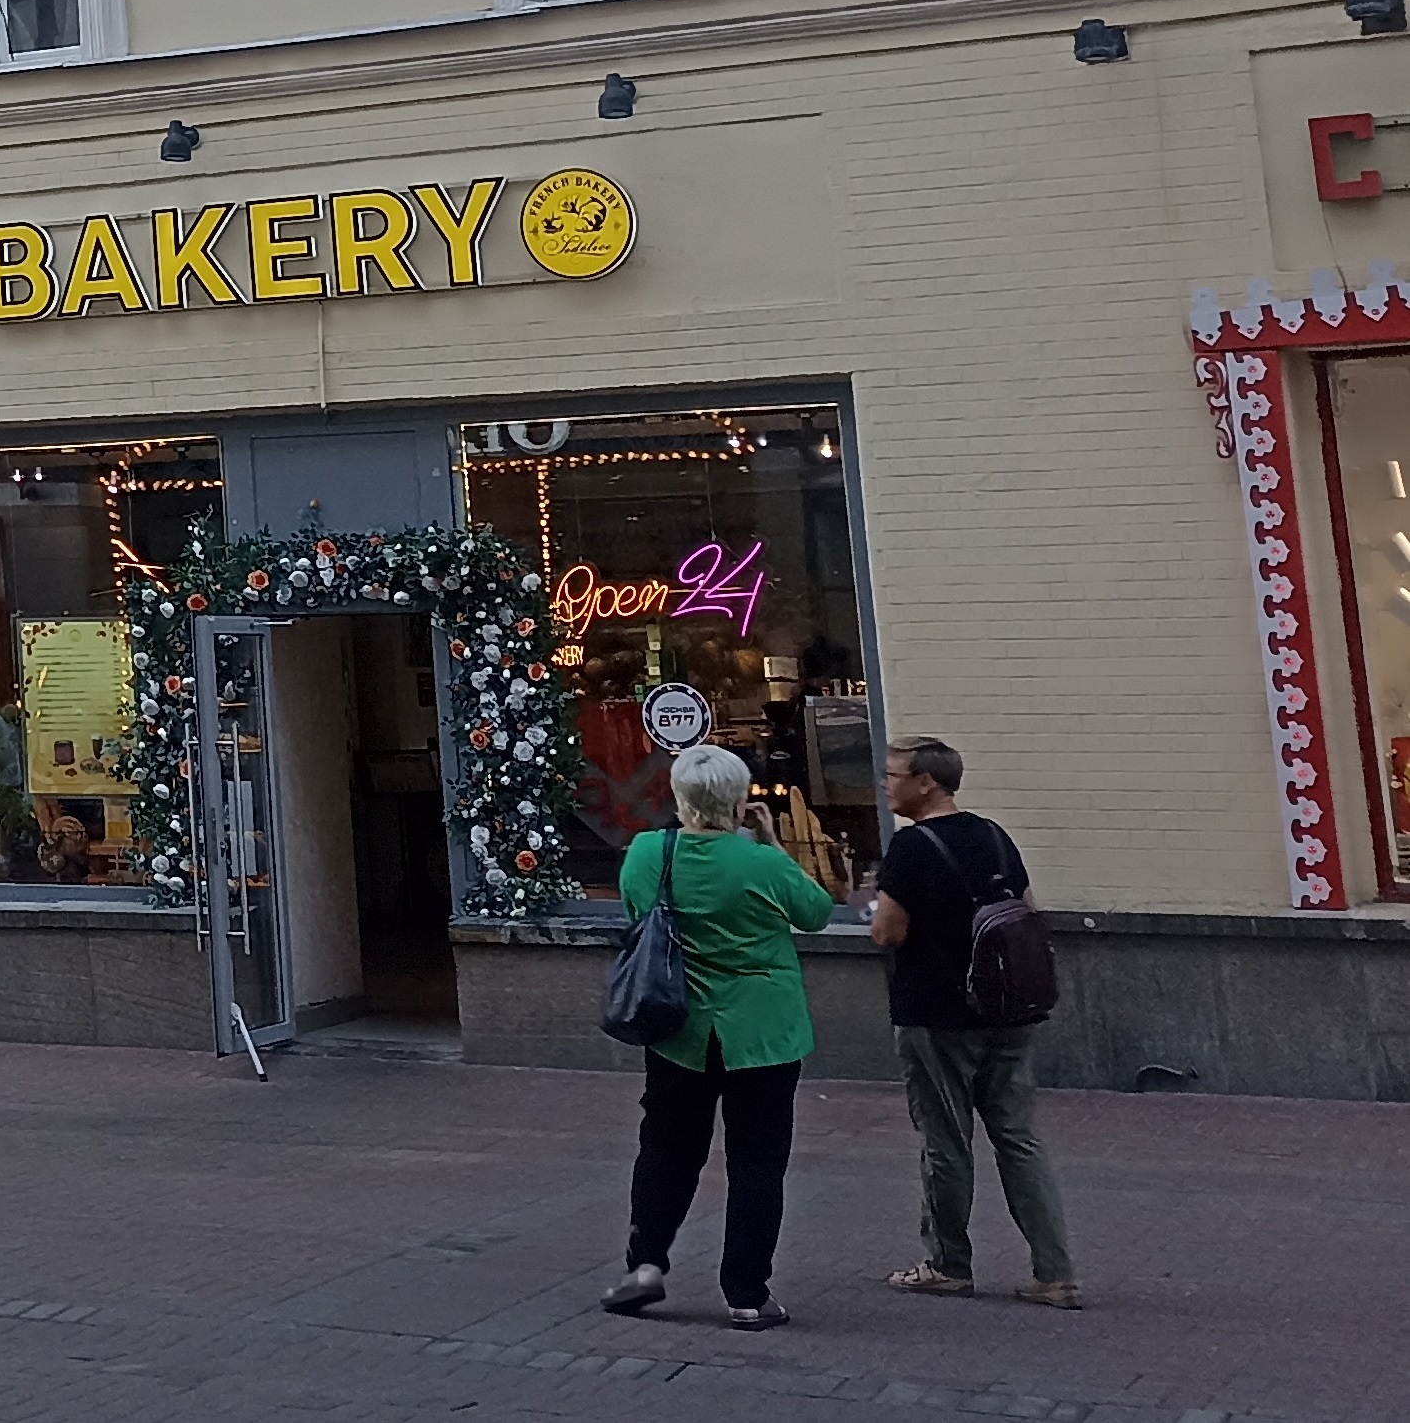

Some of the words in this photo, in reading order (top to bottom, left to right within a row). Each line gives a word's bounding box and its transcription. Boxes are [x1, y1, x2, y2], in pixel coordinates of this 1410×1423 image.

[530, 177, 569, 216] FRENCH
[575, 176, 621, 209] BAKERY
[552, 564, 669, 636] Open
[670, 541, 765, 638] 24
[658, 714, 695, 727] 877
